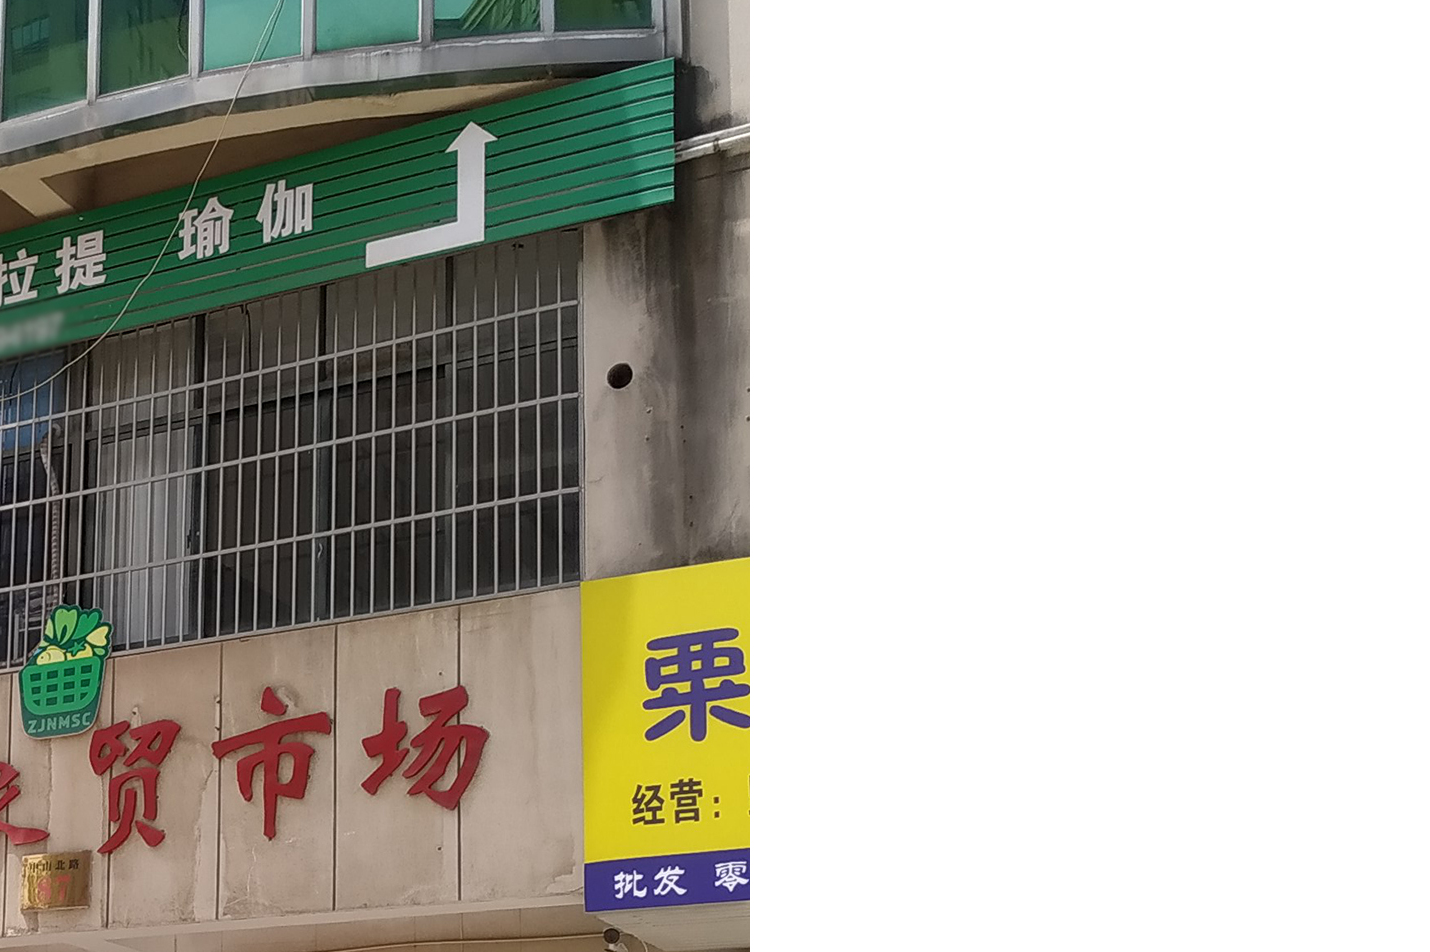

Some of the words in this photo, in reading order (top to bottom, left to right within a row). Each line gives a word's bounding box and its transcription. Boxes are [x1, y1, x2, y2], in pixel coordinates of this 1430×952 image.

[178, 179, 315, 261] 瑜伽
[27, 712, 92, 734] ZJNMSC
[613, 866, 688, 899] 批发
[714, 860, 750, 893] 零
